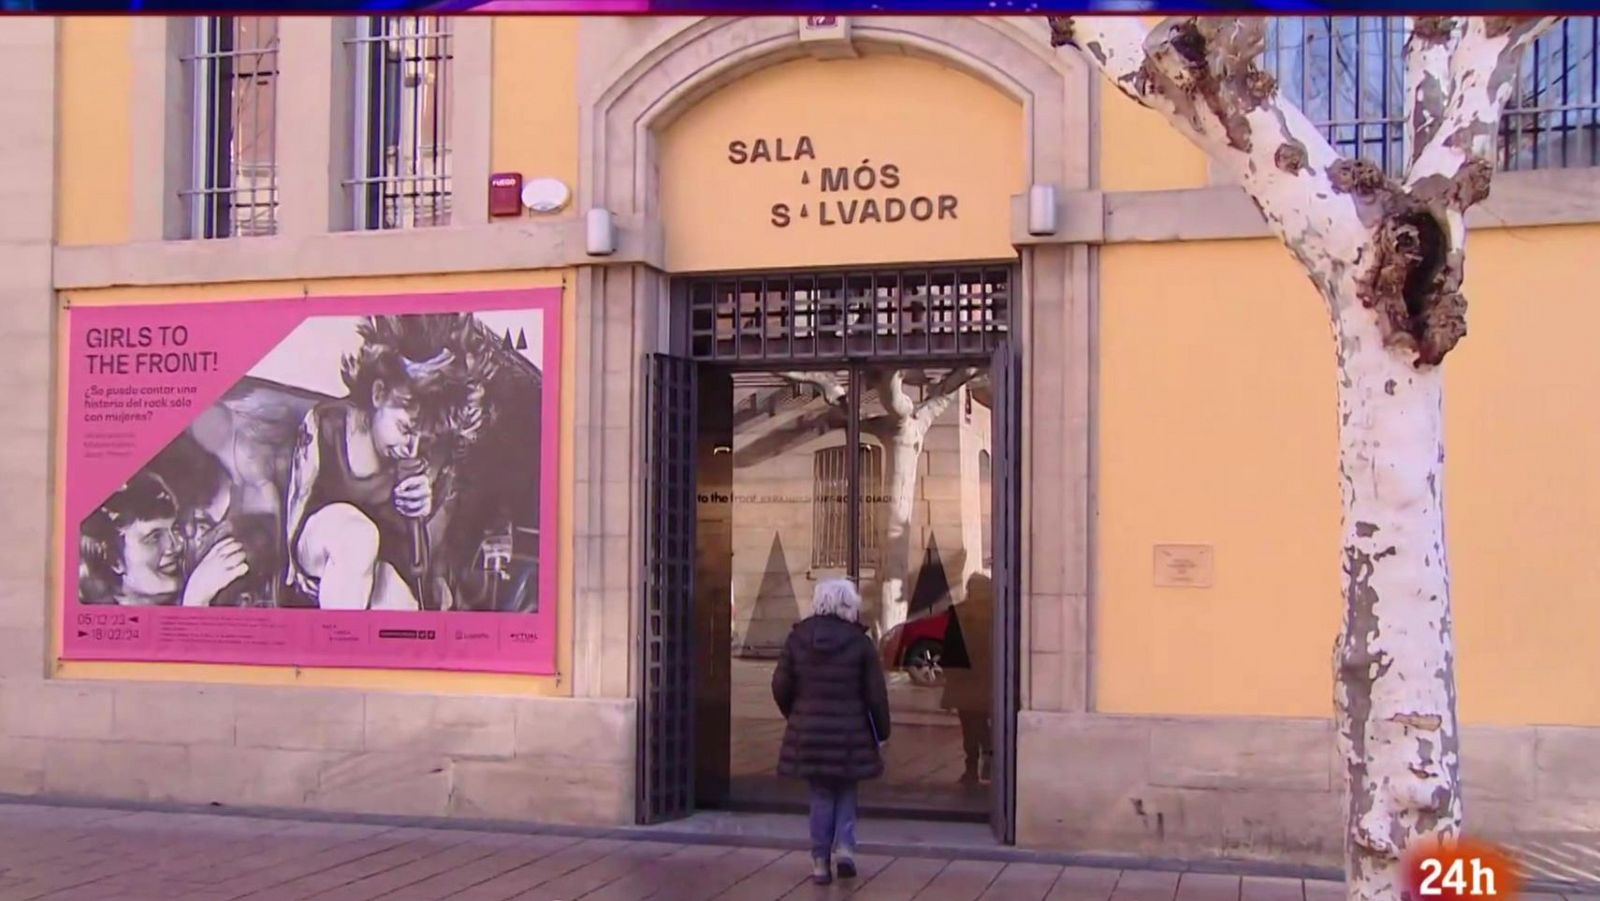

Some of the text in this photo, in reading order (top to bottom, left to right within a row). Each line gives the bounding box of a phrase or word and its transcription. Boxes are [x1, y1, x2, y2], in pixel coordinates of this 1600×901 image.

[728, 135, 815, 165] SALA
[86, 325, 188, 348] GIRLS TO
[85, 351, 218, 374] THE FRONT!
[84, 384, 197, 398] ¿Se puede contar una
[84, 399, 125, 409] historia
[126, 398, 142, 408] del
[144, 398, 169, 408] rock
[84, 411, 153, 423] con mujeres?
[697, 494, 709, 504] to
[711, 492, 728, 504] the
